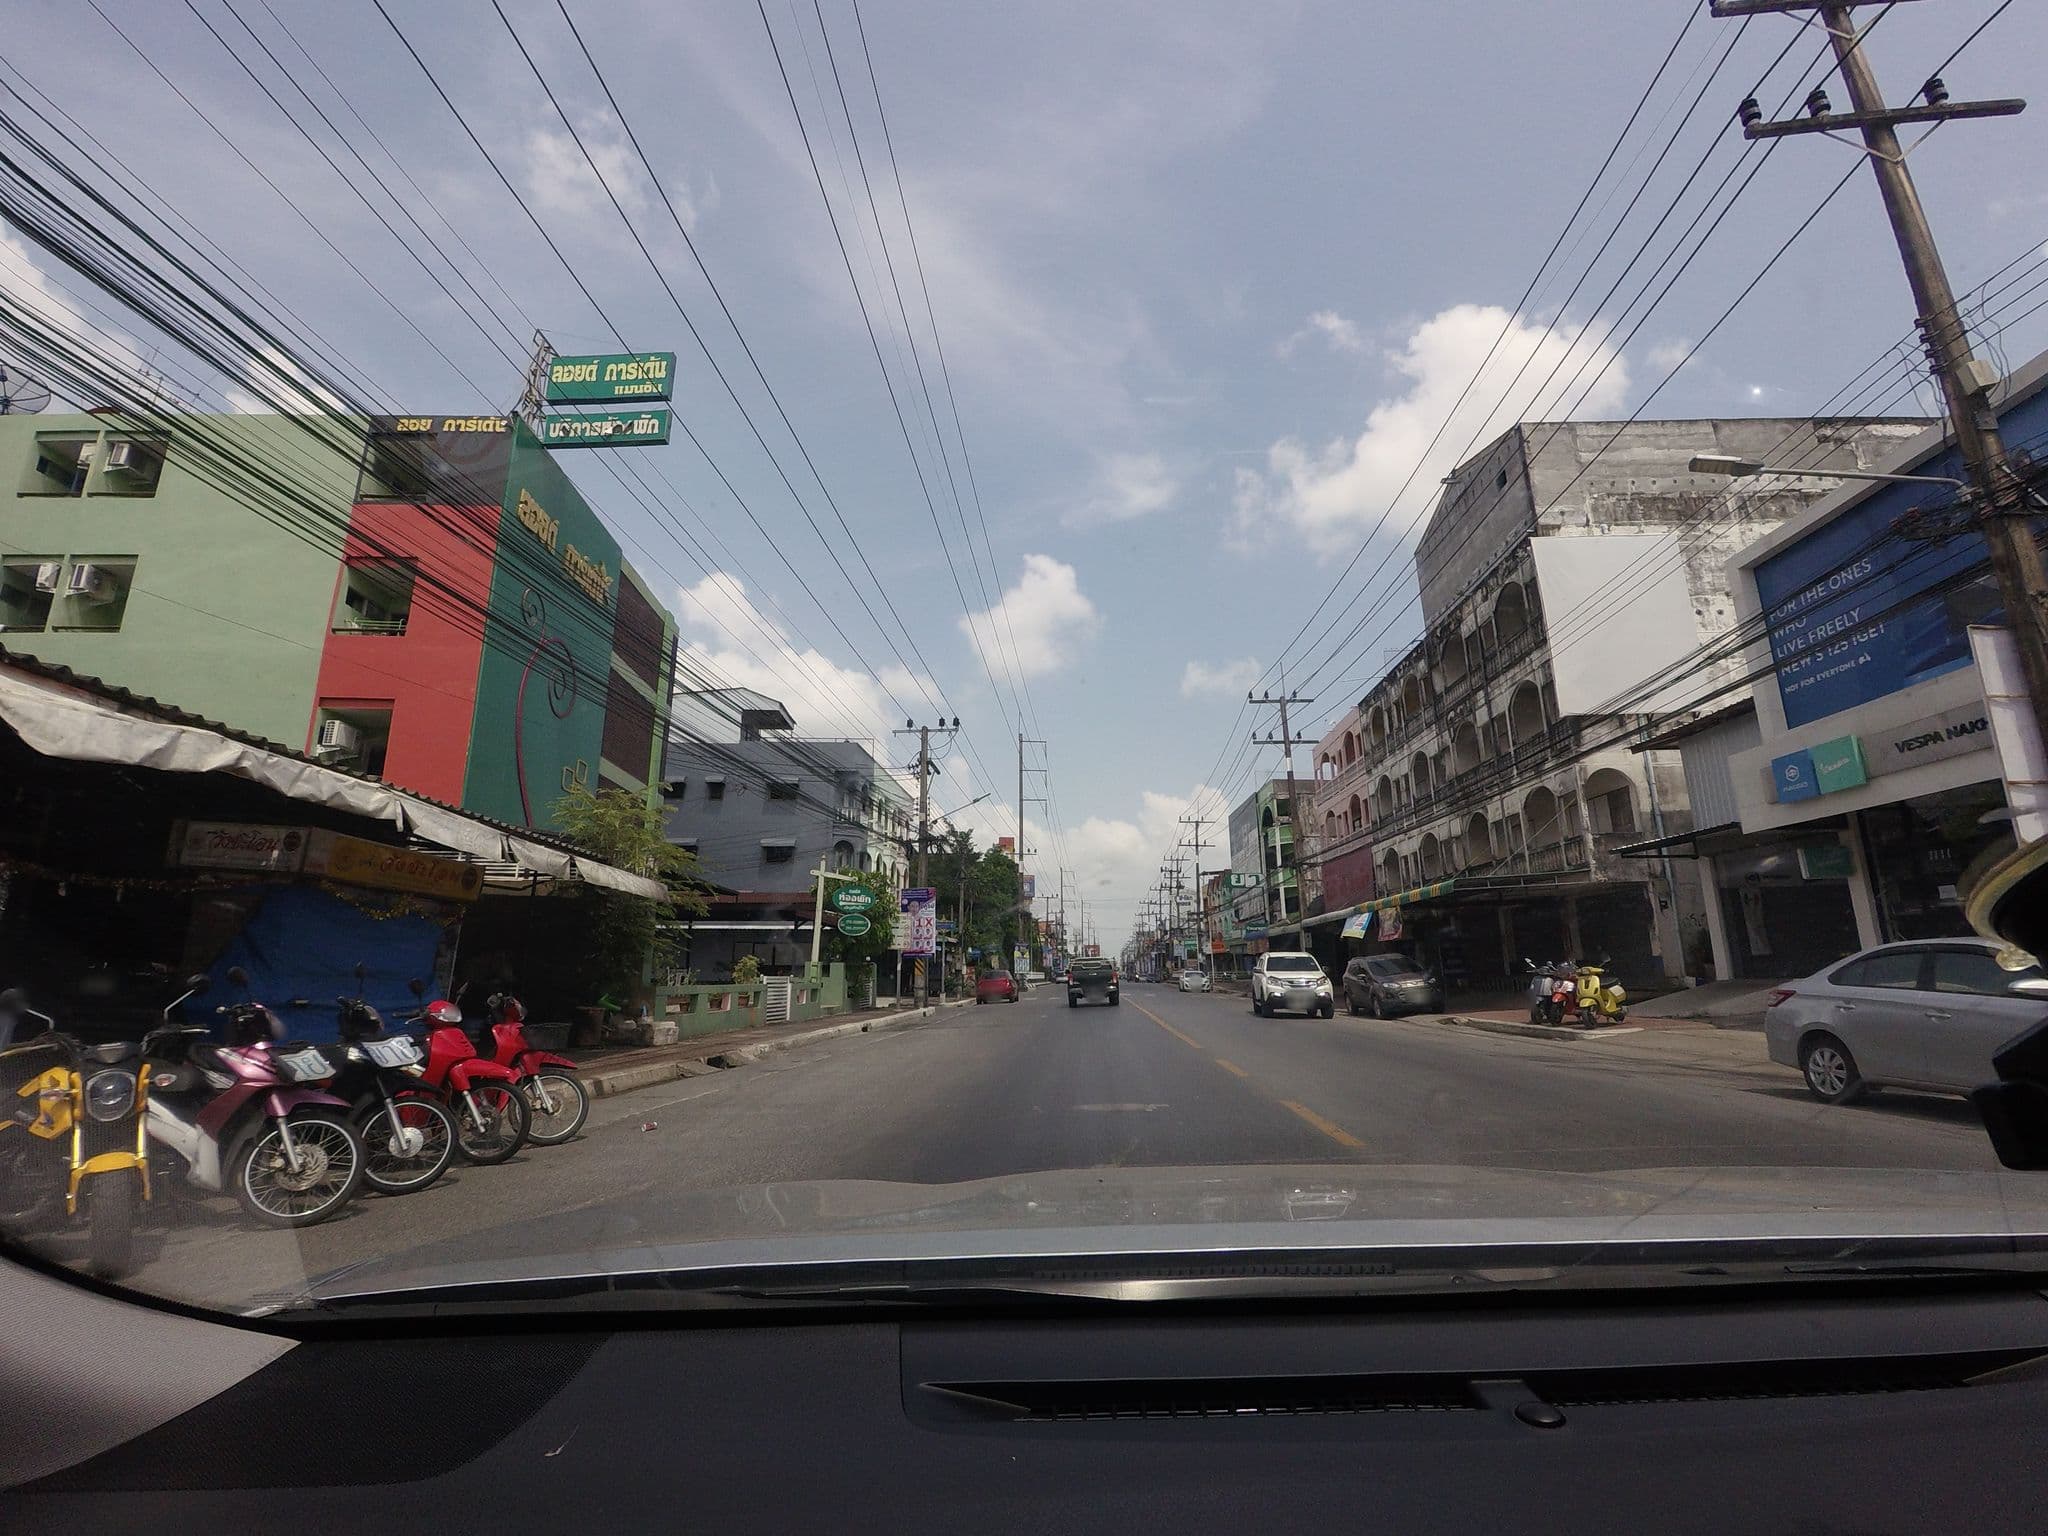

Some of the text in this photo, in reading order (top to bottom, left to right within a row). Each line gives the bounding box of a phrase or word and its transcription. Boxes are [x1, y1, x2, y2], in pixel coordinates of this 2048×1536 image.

[1769, 558, 1872, 622] FOR THE ONES
[1773, 614, 1807, 639] WHO
[1777, 607, 1862, 658] LIVE FREELY
[1781, 654, 1812, 677] NEW
[1800, 677, 1816, 688] FOR
[1816, 660, 1856, 682] EVERYONE
[1895, 730, 1945, 754] VESPA
[283, 1052, 328, 1078] าย
